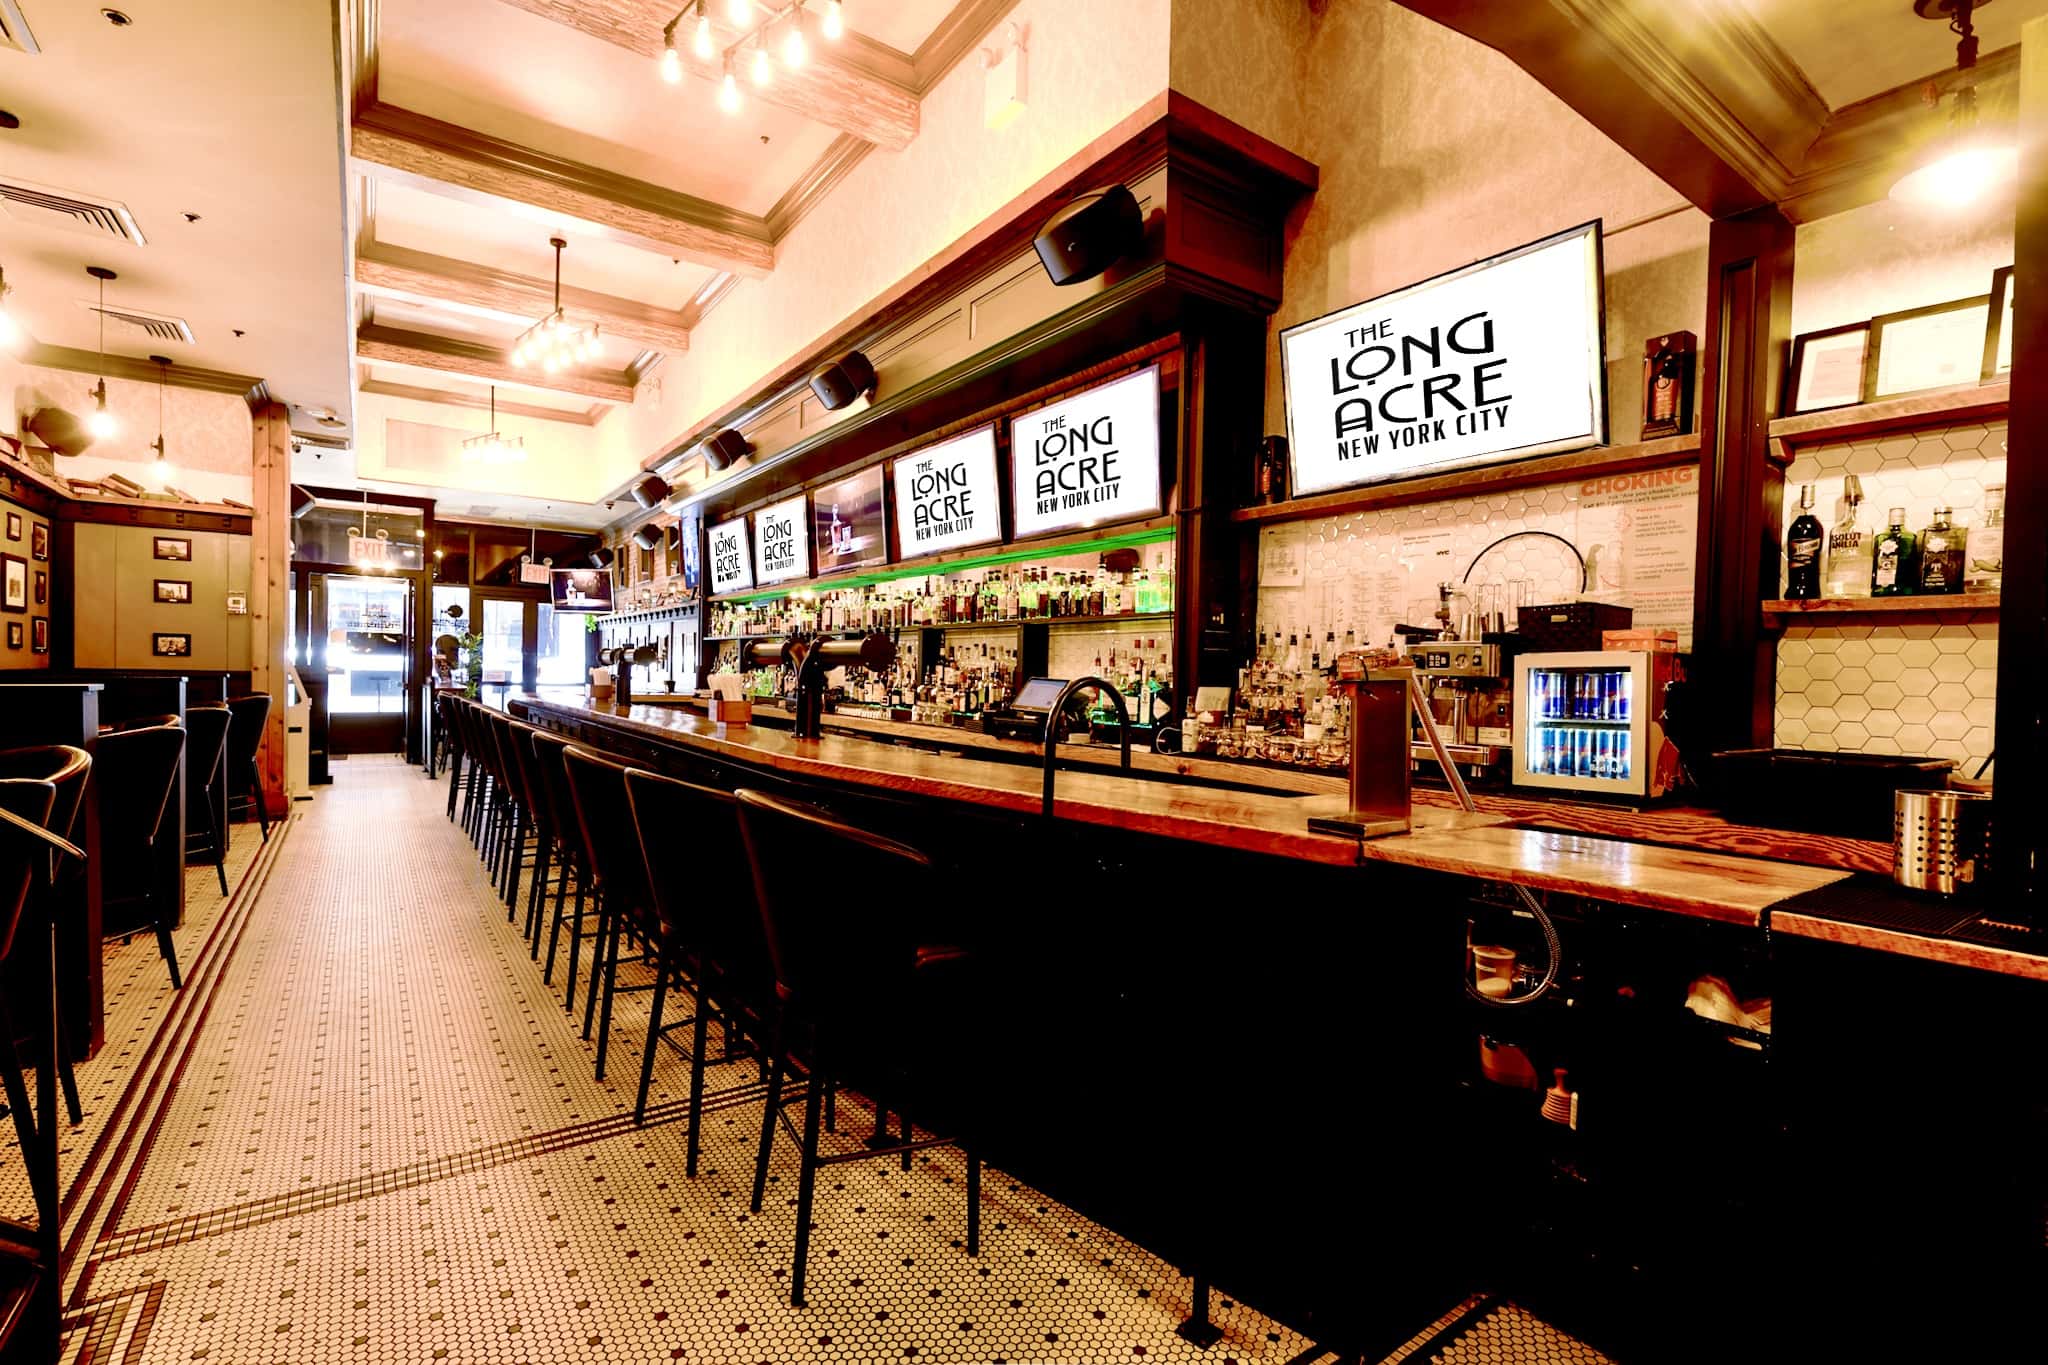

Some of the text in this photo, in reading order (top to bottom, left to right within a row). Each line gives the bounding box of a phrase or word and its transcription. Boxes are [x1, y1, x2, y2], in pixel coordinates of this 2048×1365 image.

[1344, 318, 1394, 347] THE
[1331, 311, 1494, 395] LONG
[1335, 358, 1512, 438] ACRE
[1042, 415, 1066, 433] THE
[1338, 404, 1508, 461] NEW YORK CITY
[1035, 415, 1112, 466] LONG
[916, 459, 933, 473] THE
[1036, 450, 1121, 498] ACRE
[911, 462, 967, 501] LONG
[1581, 467, 1693, 496] CHOKING
[914, 490, 974, 528] ACRE
[1037, 483, 1119, 515] NEW YORK CITY
[763, 519, 792, 543] LONG
[916, 516, 973, 541] NEW YORK CITY
[1831, 532, 1861, 541] SOLUT
[353, 541, 384, 560] EXIT
[715, 535, 737, 556] LONG
[765, 539, 795, 562] ACRE
[716, 552, 741, 574] ACRE
